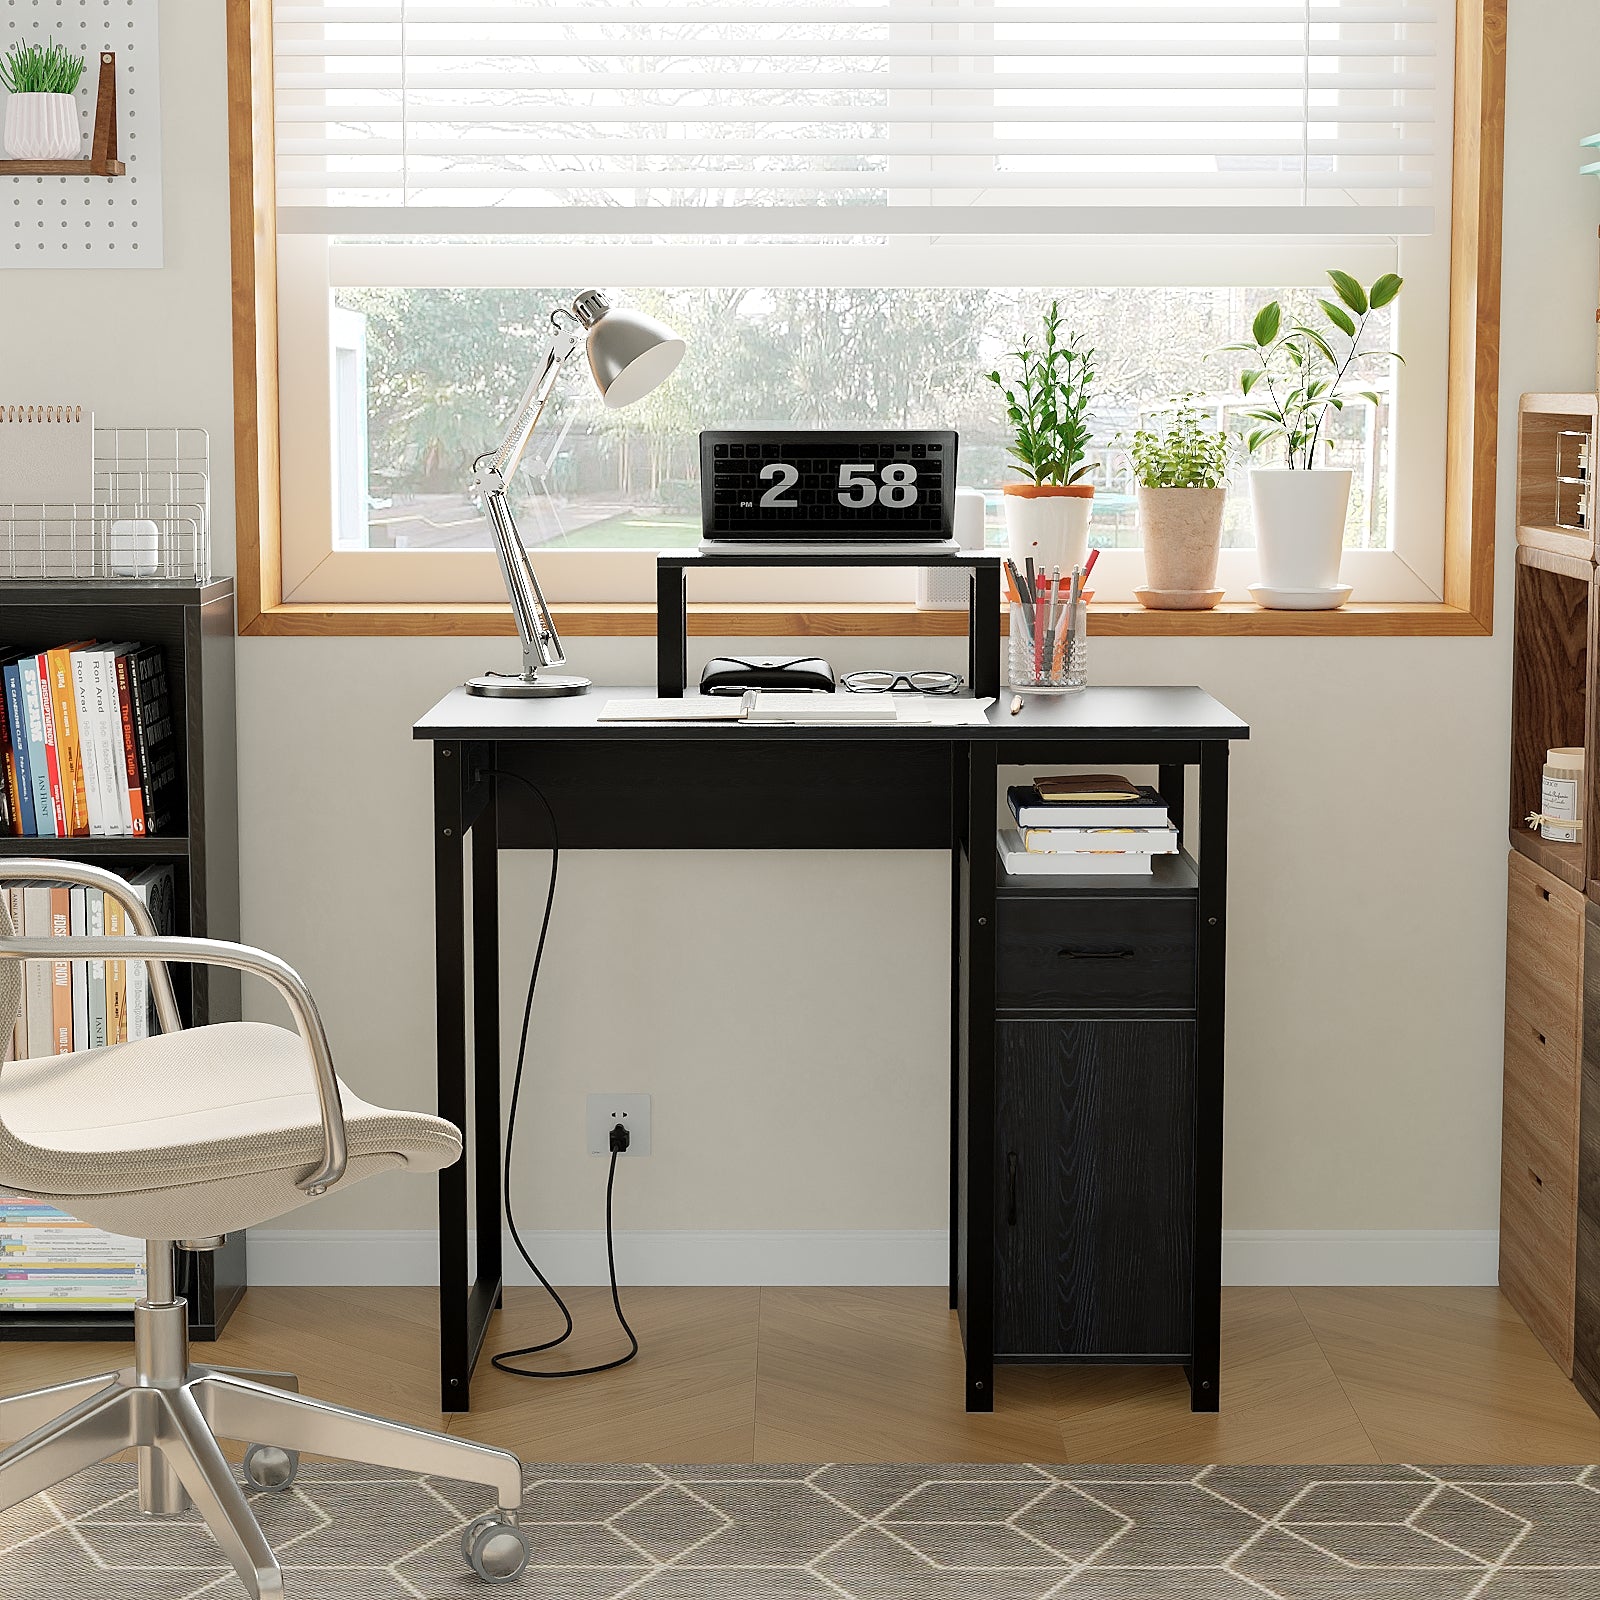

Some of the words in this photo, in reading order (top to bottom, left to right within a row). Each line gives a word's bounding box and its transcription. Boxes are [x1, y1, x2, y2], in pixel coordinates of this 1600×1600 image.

[759, 464, 799, 508] 2
[838, 464, 918, 508] 58
[24, 670, 42, 742] STEAM
[41, 679, 54, 746] #DISRUPTMENOW
[80, 686, 88, 713] Arad
[96, 686, 104, 713] Arad
[124, 724, 132, 750] Black
[127, 752, 135, 776] Tulip
[54, 914, 68, 986] #DISENOW
[92, 900, 104, 980] STEM
